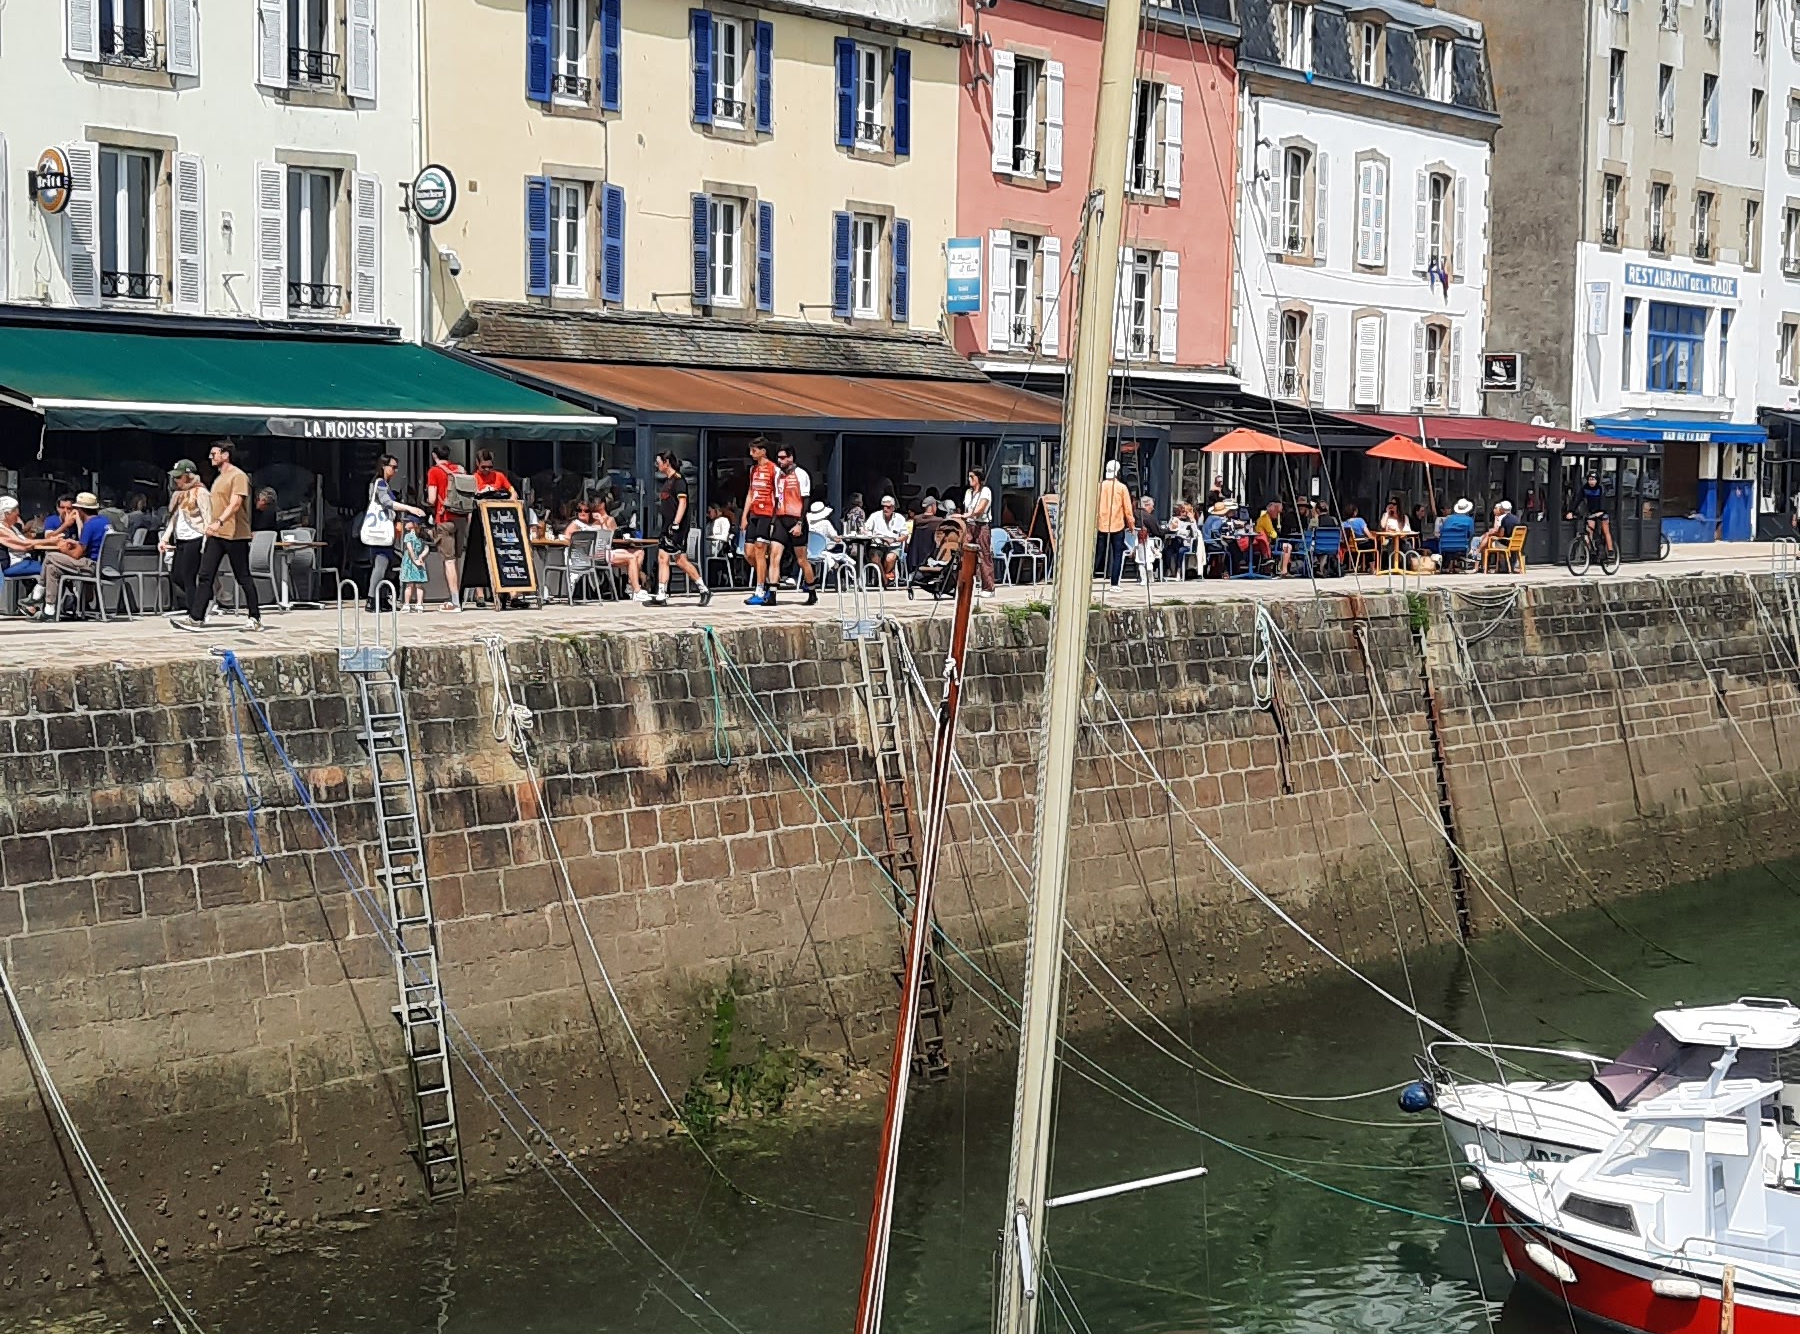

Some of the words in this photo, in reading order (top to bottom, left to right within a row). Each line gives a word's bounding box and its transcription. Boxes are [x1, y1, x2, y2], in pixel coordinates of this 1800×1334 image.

[1628, 266, 1690, 290] RESTAURANT
[1711, 277, 1735, 295] RADE
[304, 420, 321, 438] LA
[326, 421, 413, 438] MOUSSETTE
